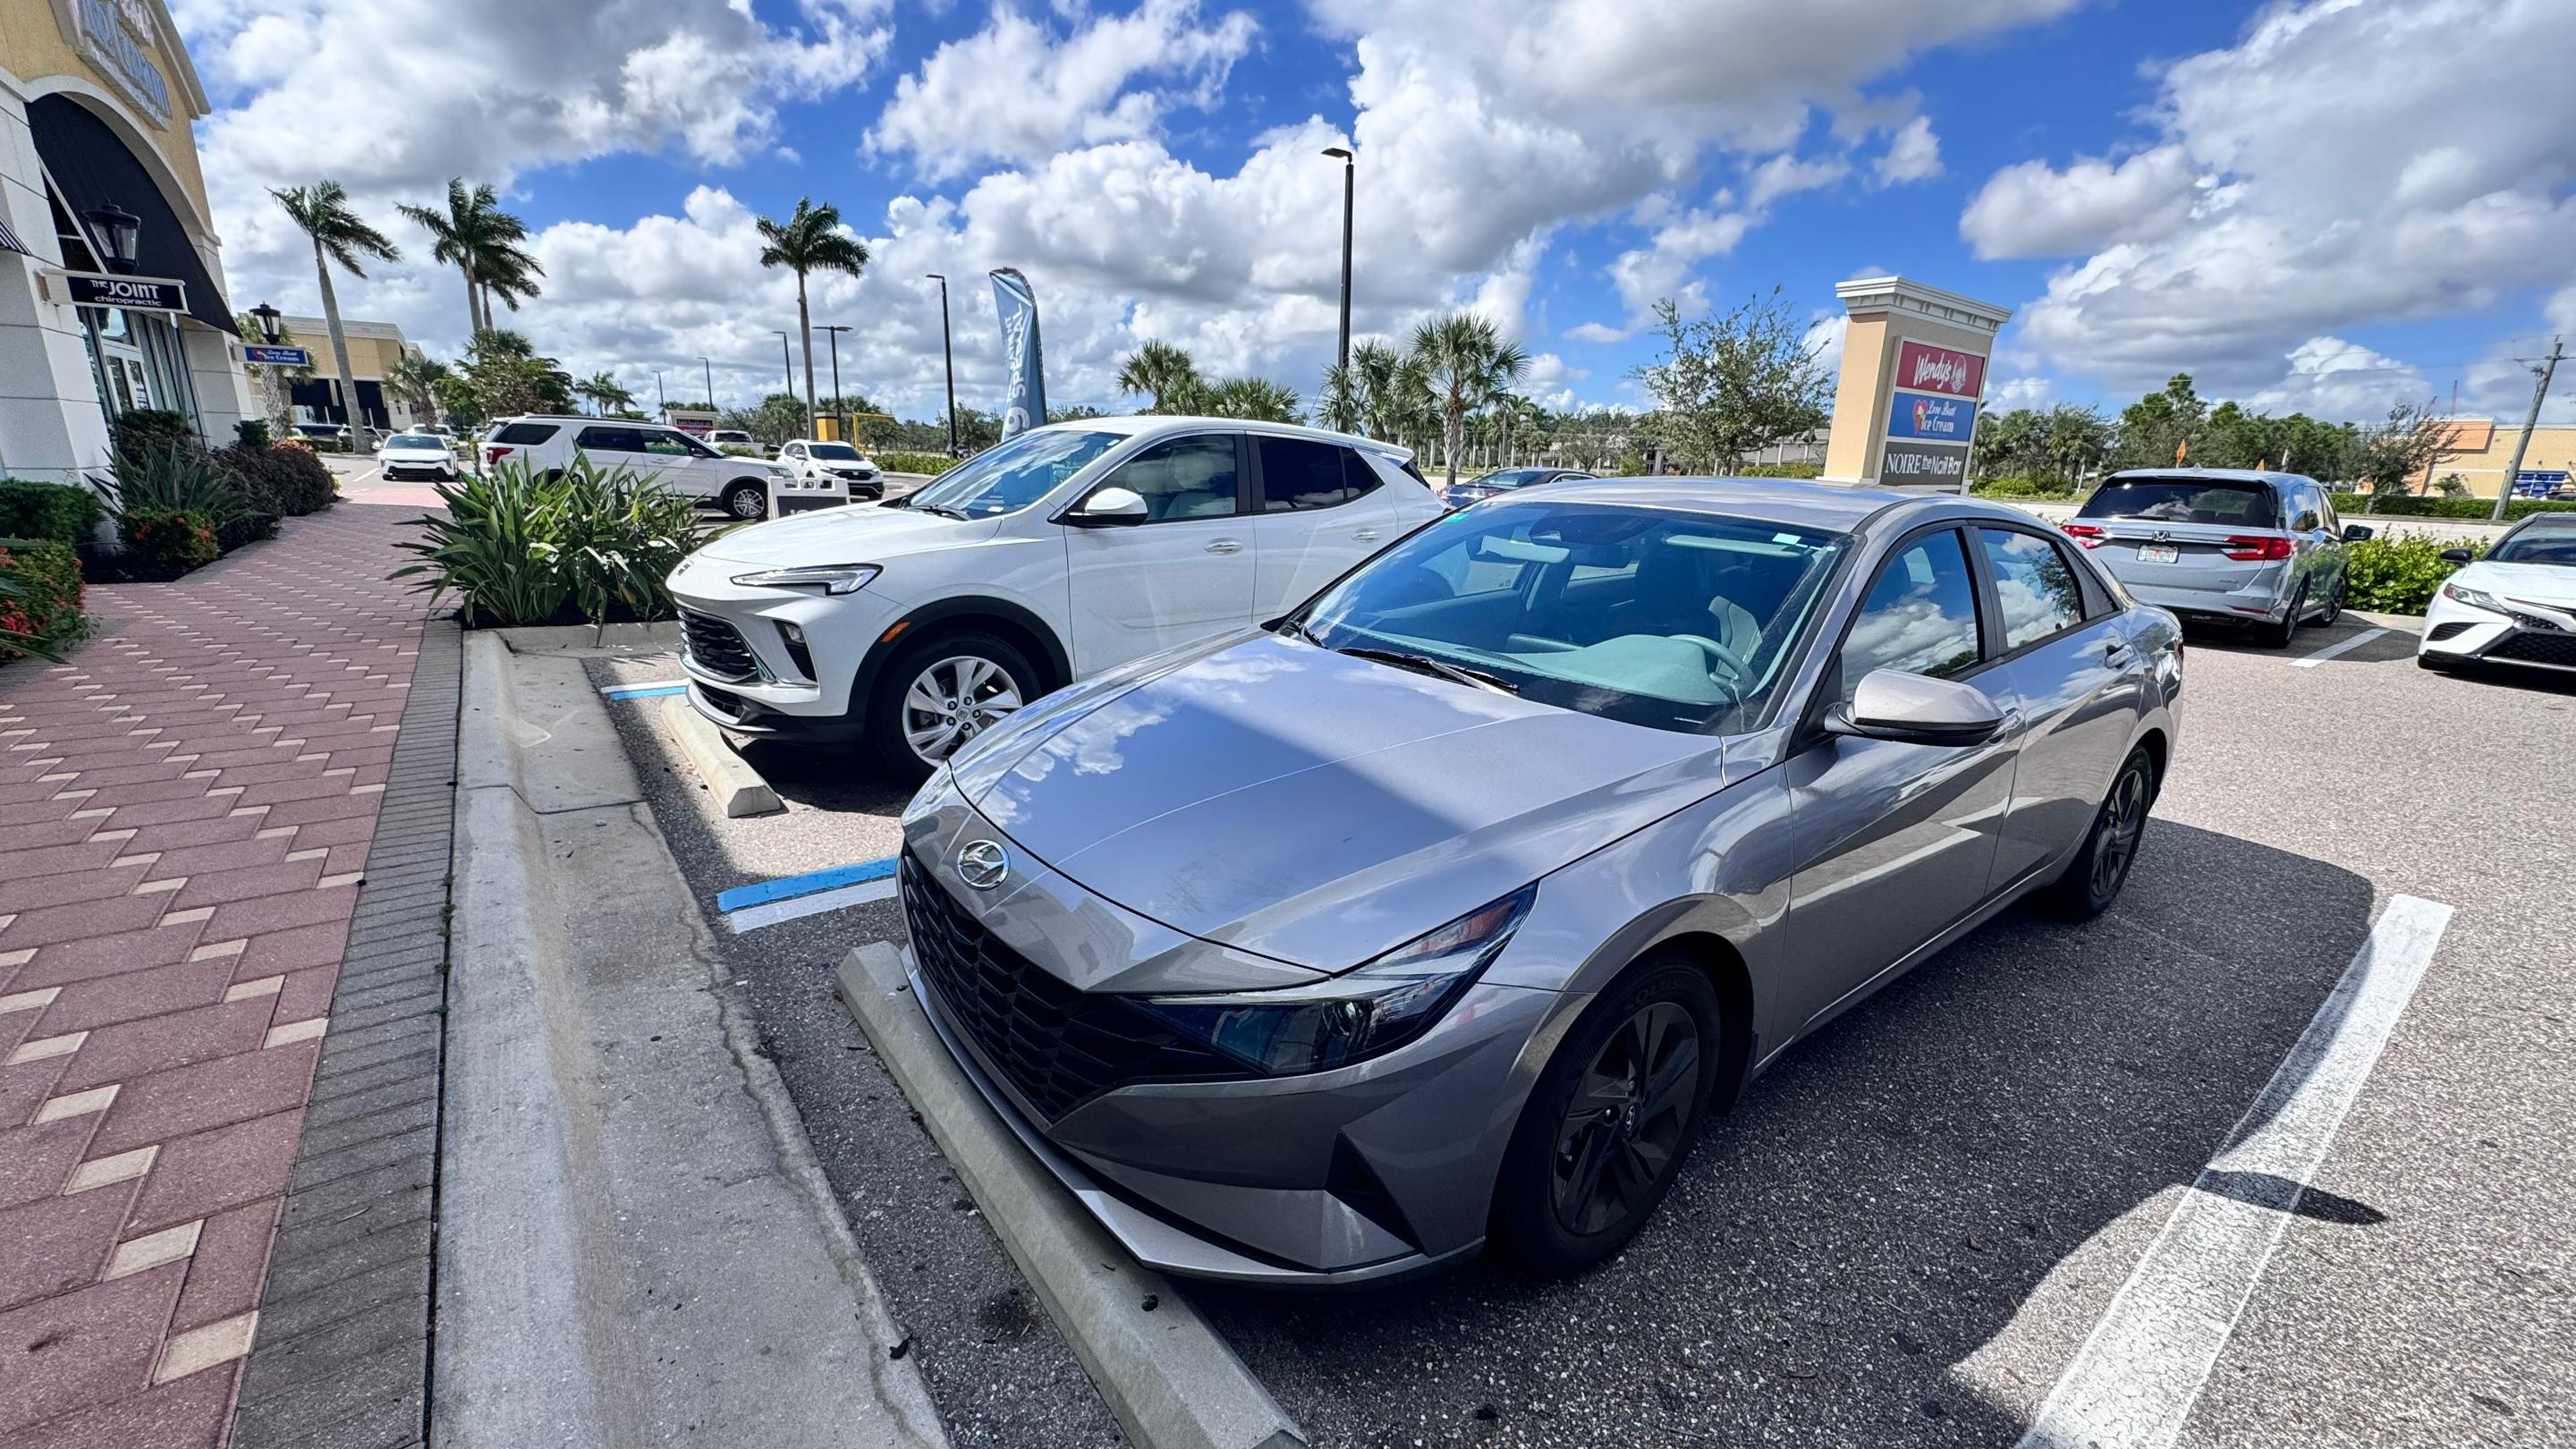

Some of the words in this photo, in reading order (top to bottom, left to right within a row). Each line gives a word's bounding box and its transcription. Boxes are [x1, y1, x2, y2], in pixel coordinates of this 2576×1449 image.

[108, 282, 159, 299] JOINT
[94, 295, 162, 307] chiropractic
[1913, 352, 1952, 390] Wendy's
[1920, 414, 1932, 431] Ice
[1932, 416, 1953, 433] Cream
[1885, 453, 1922, 474] NOIRE
[1921, 454, 1932, 470] the
[1930, 455, 1949, 474] Nail
[1947, 456, 1962, 475] Bar
